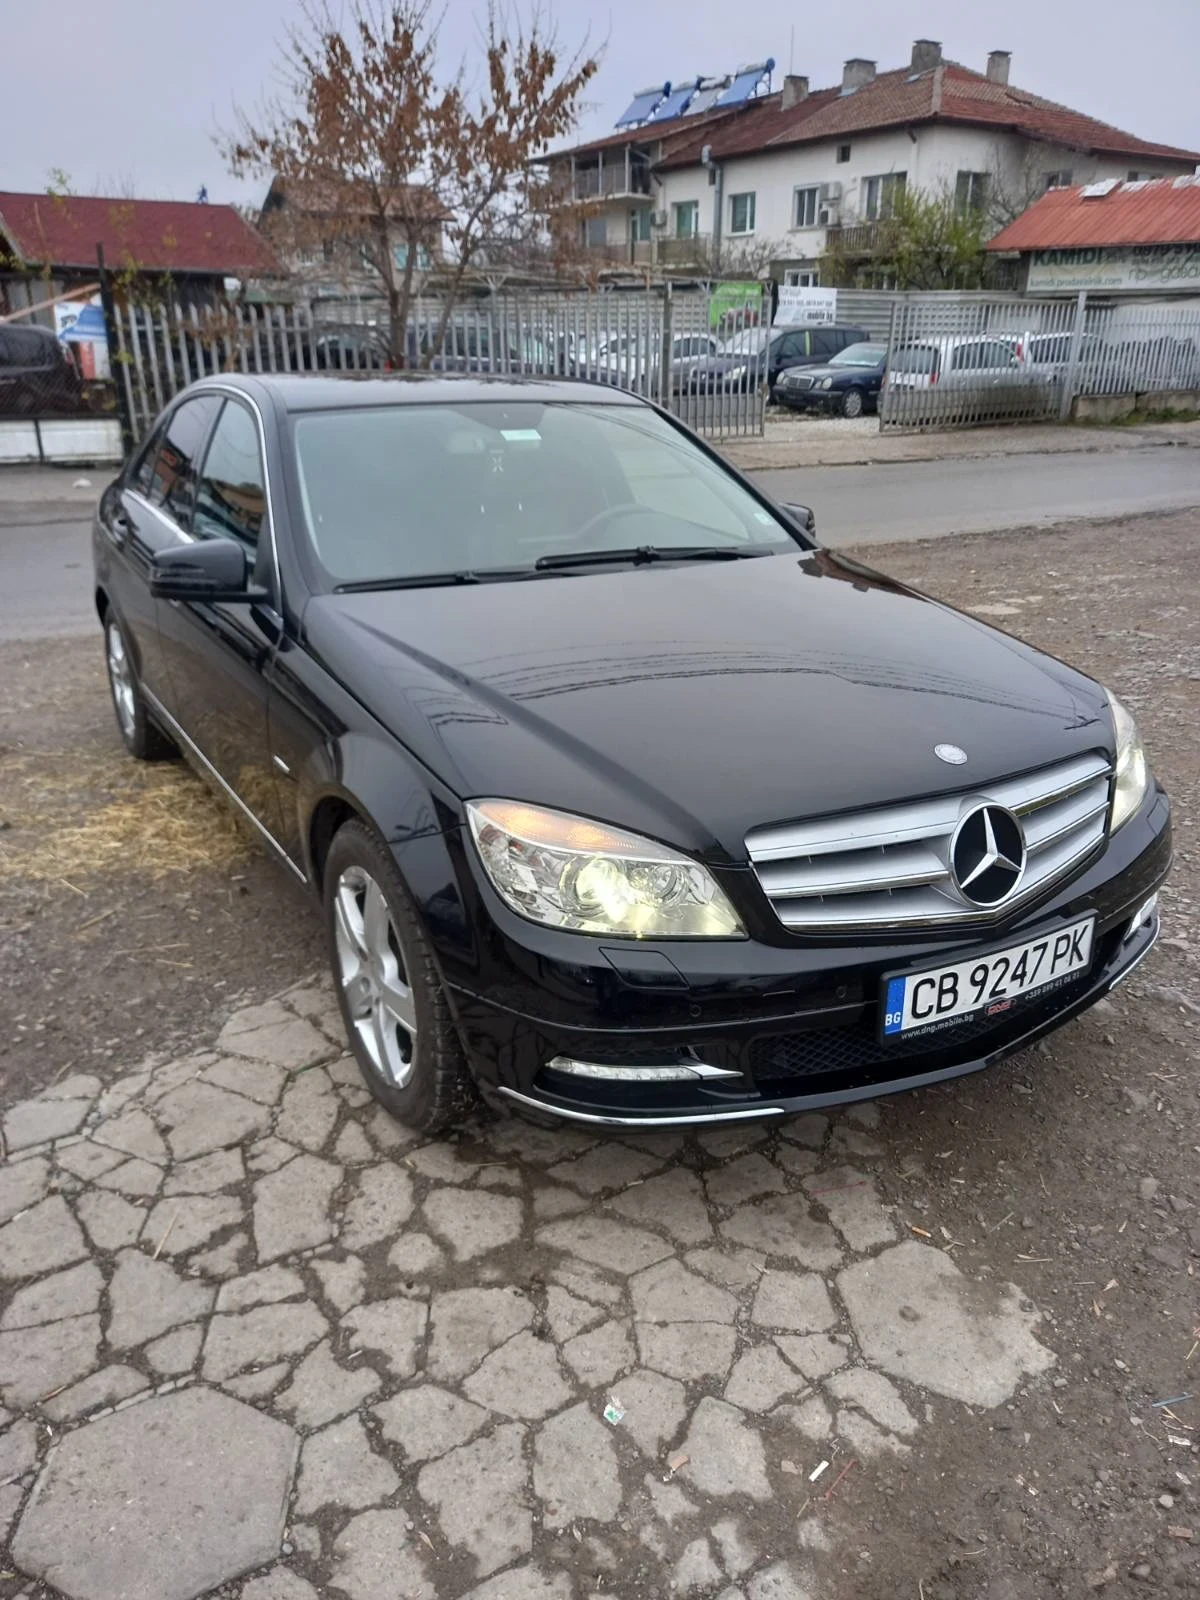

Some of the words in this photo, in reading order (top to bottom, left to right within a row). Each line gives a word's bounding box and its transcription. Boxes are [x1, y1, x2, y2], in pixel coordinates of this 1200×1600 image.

[911, 972, 958, 1019] CB
[969, 941, 1048, 1004] 9247
[1050, 925, 1089, 975] PK
[885, 1011, 901, 1026] BG
[901, 1013, 974, 1040] www.dng.mobile.bg
